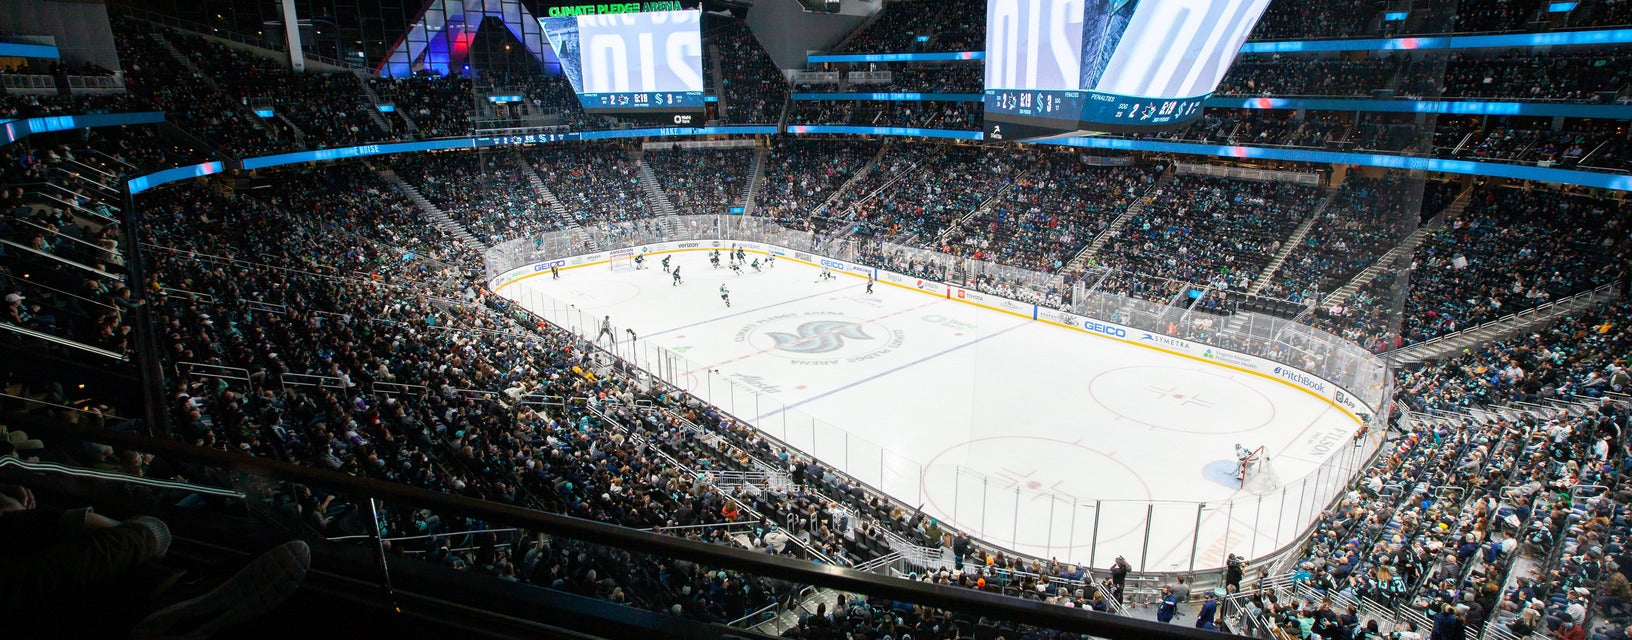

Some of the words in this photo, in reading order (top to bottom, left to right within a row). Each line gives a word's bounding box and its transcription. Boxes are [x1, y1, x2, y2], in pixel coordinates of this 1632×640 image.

[549, 5, 595, 16] CLIMATE
[597, 3, 640, 14] PLEDGE
[643, 1, 682, 12] ARENA
[610, 94, 616, 105] 2
[1002, 92, 1007, 108] 2
[1046, 94, 1052, 112] 3
[1091, 93, 1115, 102] PENALTIES
[1128, 103, 1140, 118] 2
[360, 144, 380, 154] NOISE
[534, 260, 566, 272] GEICO
[820, 259, 844, 270] GEICO
[1084, 321, 1125, 337] GEICO
[1154, 335, 1190, 349] SYMETRA
[1282, 368, 1325, 394] PitchBook
